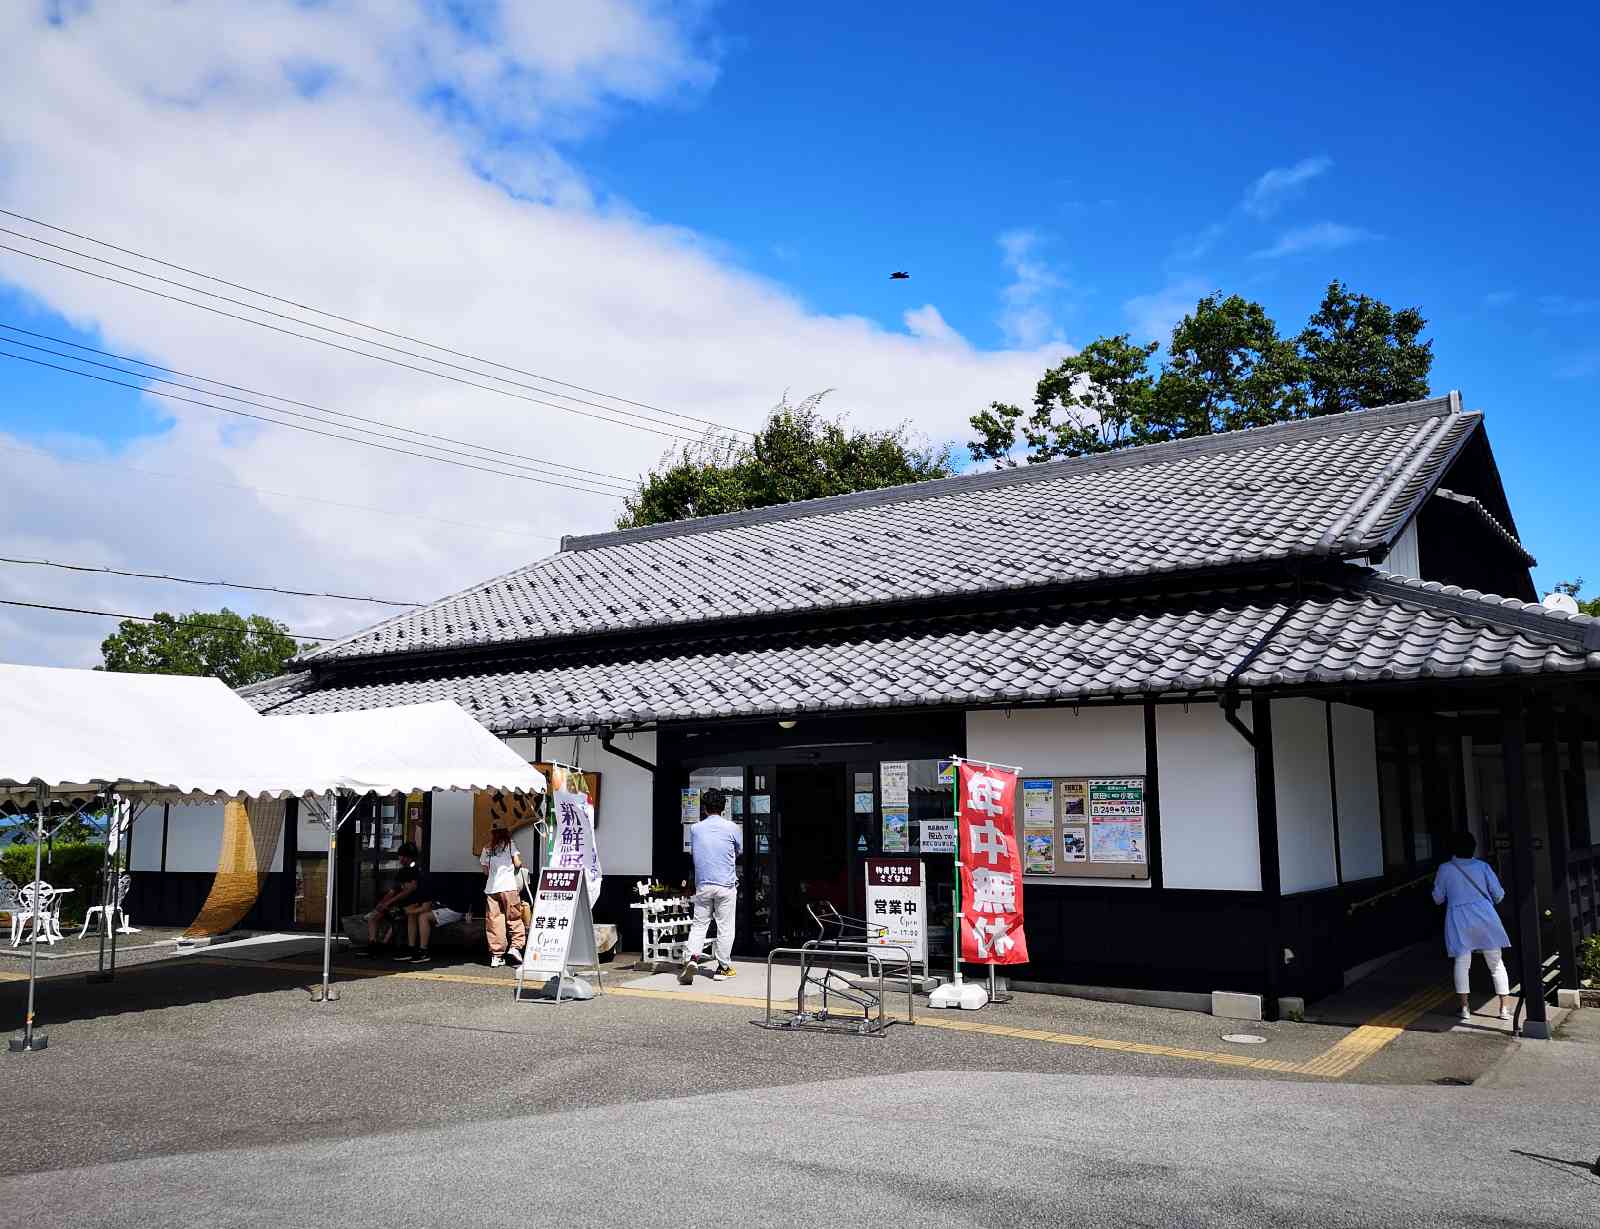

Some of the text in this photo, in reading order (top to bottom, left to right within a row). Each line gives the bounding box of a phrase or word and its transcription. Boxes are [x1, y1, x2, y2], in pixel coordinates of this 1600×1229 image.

[967, 770, 1016, 959] 年中無休
[880, 875, 909, 883] さざなみ
[874, 899, 917, 915] 営業中
[535, 916, 569, 930] 営業中
[900, 916, 918, 928] Open
[537, 931, 559, 946] Open
